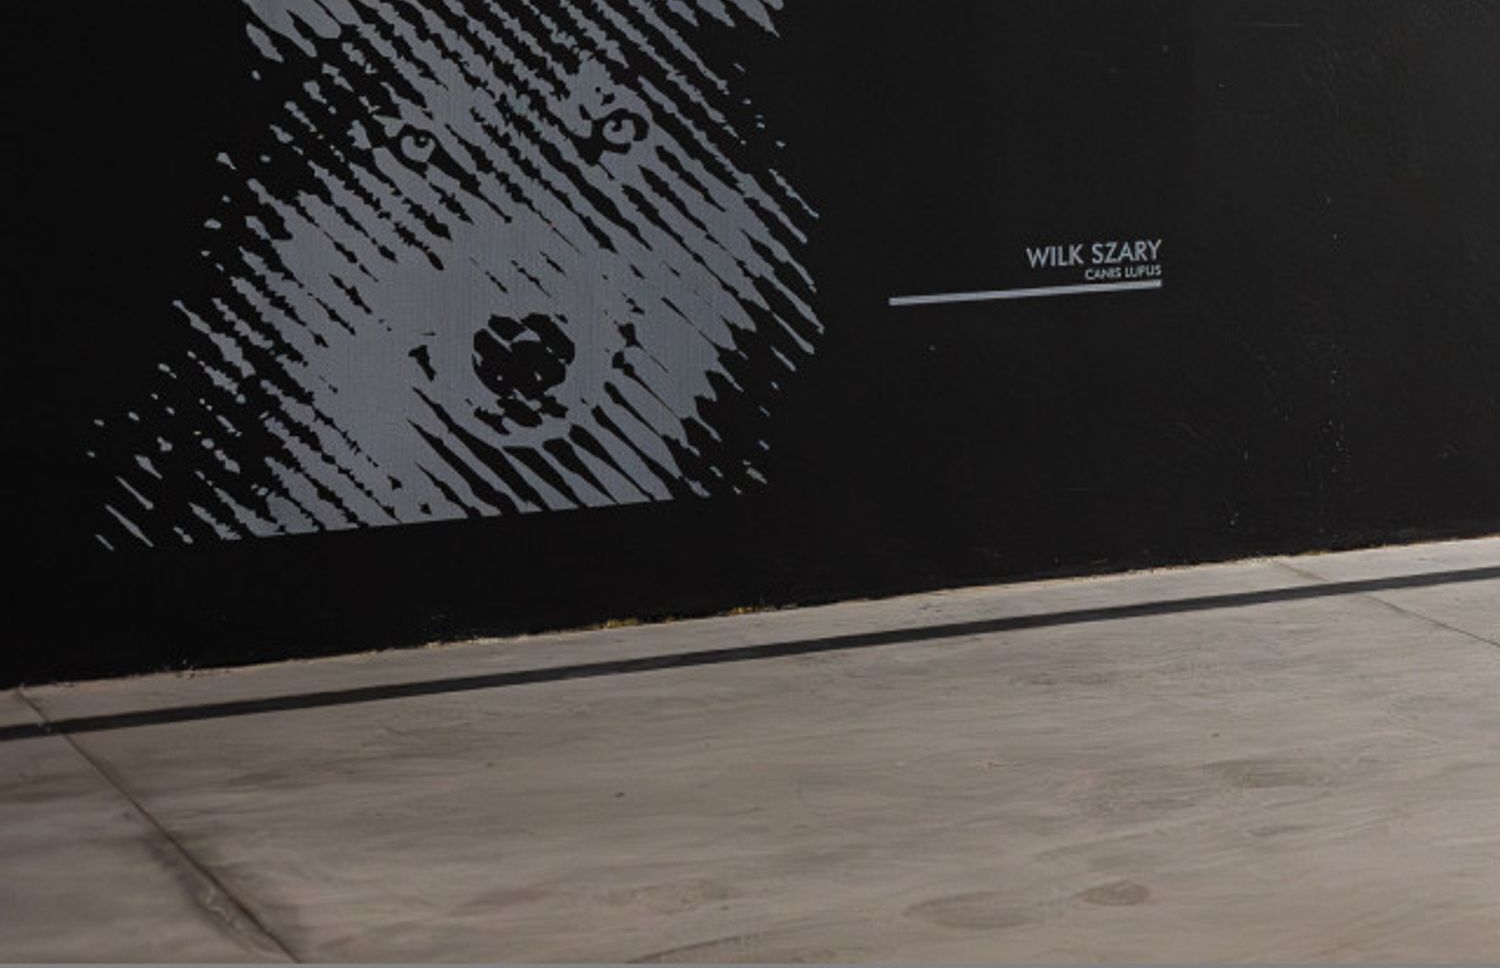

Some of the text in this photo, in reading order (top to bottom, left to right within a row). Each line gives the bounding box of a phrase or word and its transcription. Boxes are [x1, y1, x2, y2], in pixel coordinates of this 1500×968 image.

[1025, 238, 1162, 268] WILK SZARY
[1084, 264, 1162, 281] CANIS LUPUS
